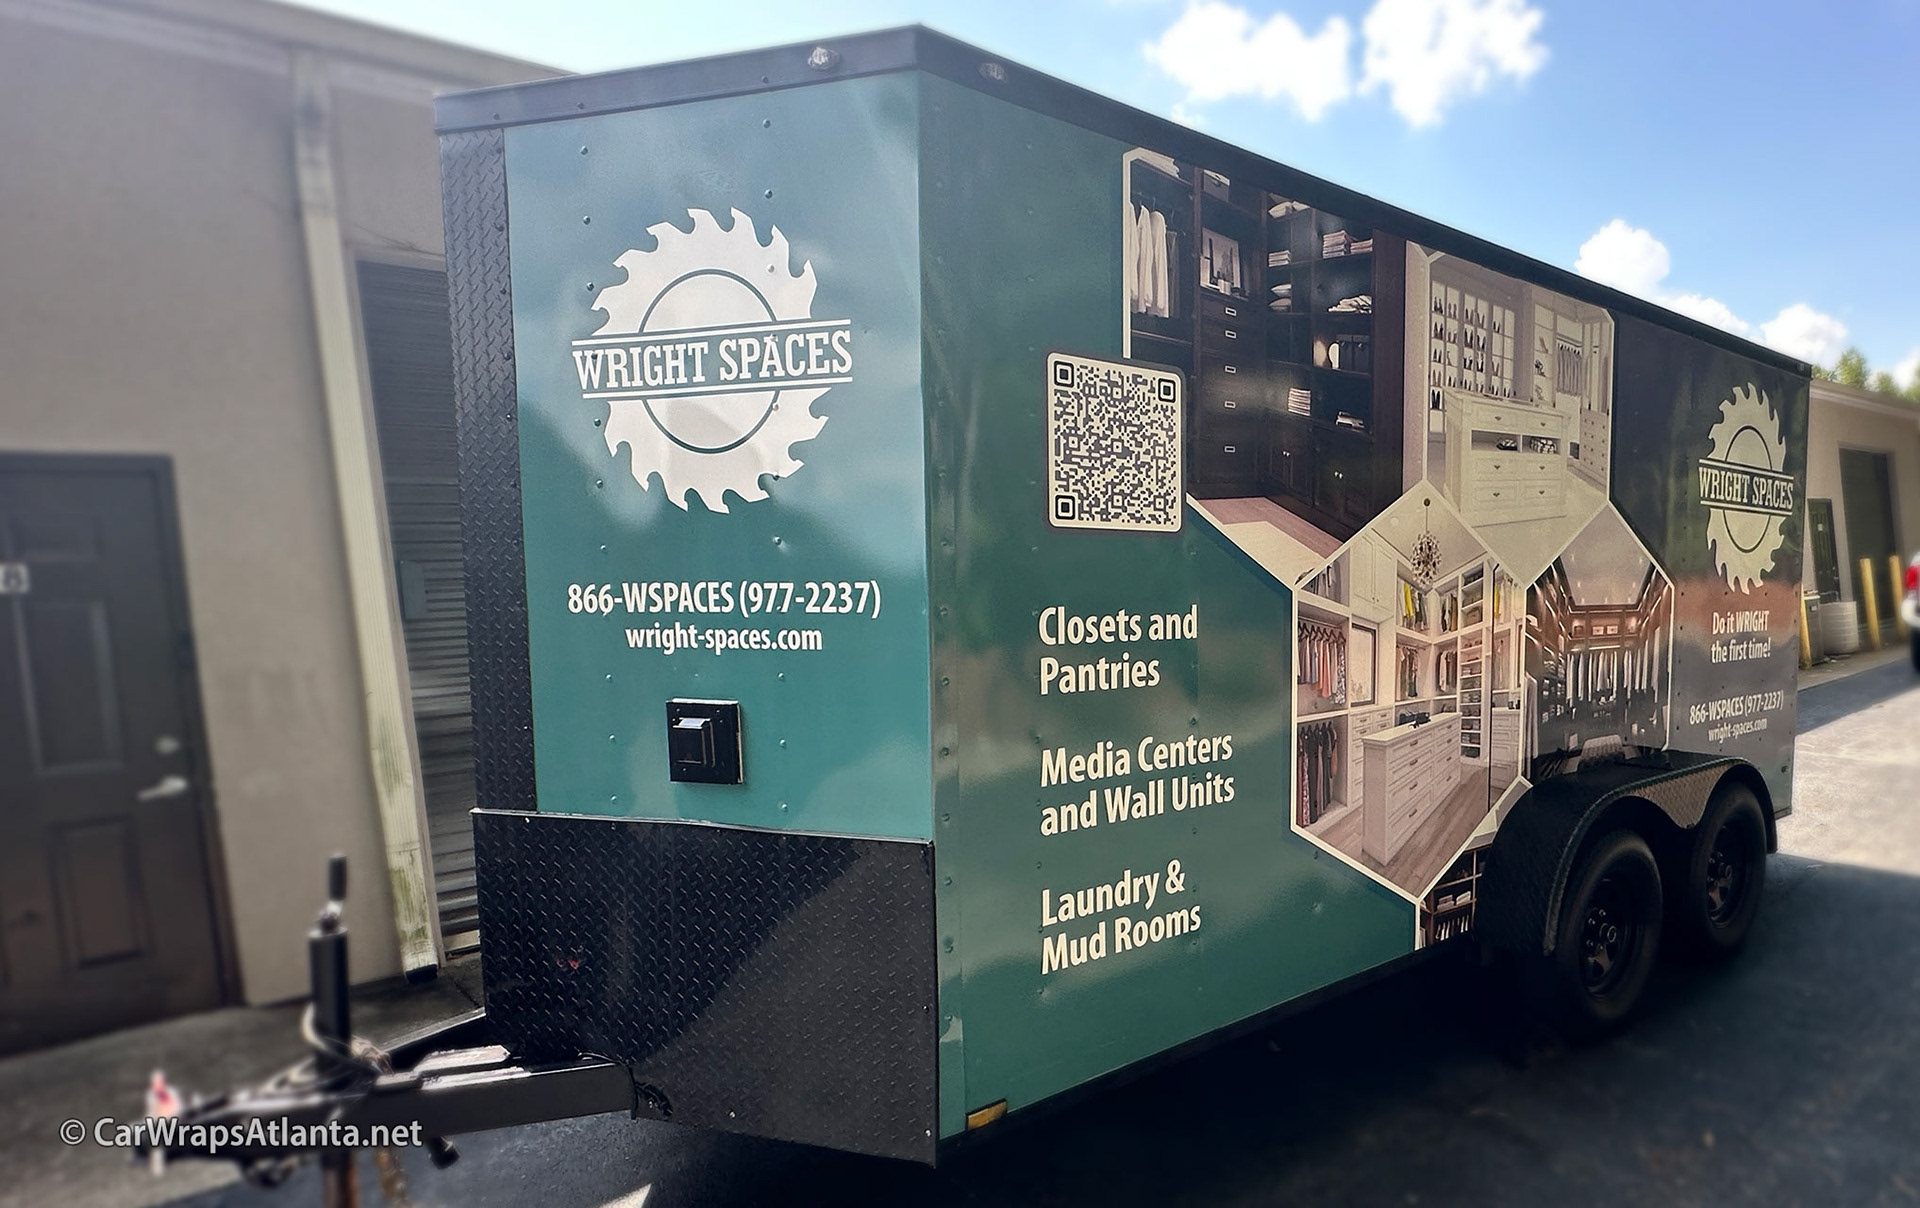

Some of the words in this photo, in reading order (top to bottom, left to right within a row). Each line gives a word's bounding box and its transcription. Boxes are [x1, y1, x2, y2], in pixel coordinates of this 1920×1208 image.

[572, 341, 709, 390] WRIGHT
[719, 330, 853, 381] SPACES
[1699, 466, 1750, 503] WRIGHT
[1752, 476, 1794, 510] SPACES
[567, 581, 734, 616] 866-WSPACES
[739, 580, 882, 618] (977-2237)
[625, 622, 823, 655] wright-spaces.com
[1039, 606, 1142, 645] Closets
[1149, 604, 1198, 641] and
[1712, 612, 1726, 635] Do
[1726, 611, 1735, 634] it
[1736, 610, 1770, 632] WRIGHT
[1711, 640, 1728, 663] the
[1729, 638, 1747, 661] first
[1748, 637, 1771, 659] time!
[1040, 652, 1161, 695] Pantries
[1689, 696, 1744, 725] 866-WSPACES
[1744, 690, 1784, 717] (977-2237)
[1708, 718, 1768, 743] wright-spaces.com
[1041, 741, 1131, 787] Media
[1138, 734, 1233, 772] Centers
[1040, 790, 1098, 836] and
[1104, 779, 1164, 823] Wall
[1172, 772, 1235, 811] Units
[1042, 869, 1160, 927] Laundry
[1165, 859, 1186, 895] &
[1041, 921, 1107, 975] Mud
[1115, 905, 1201, 953] Rooms
